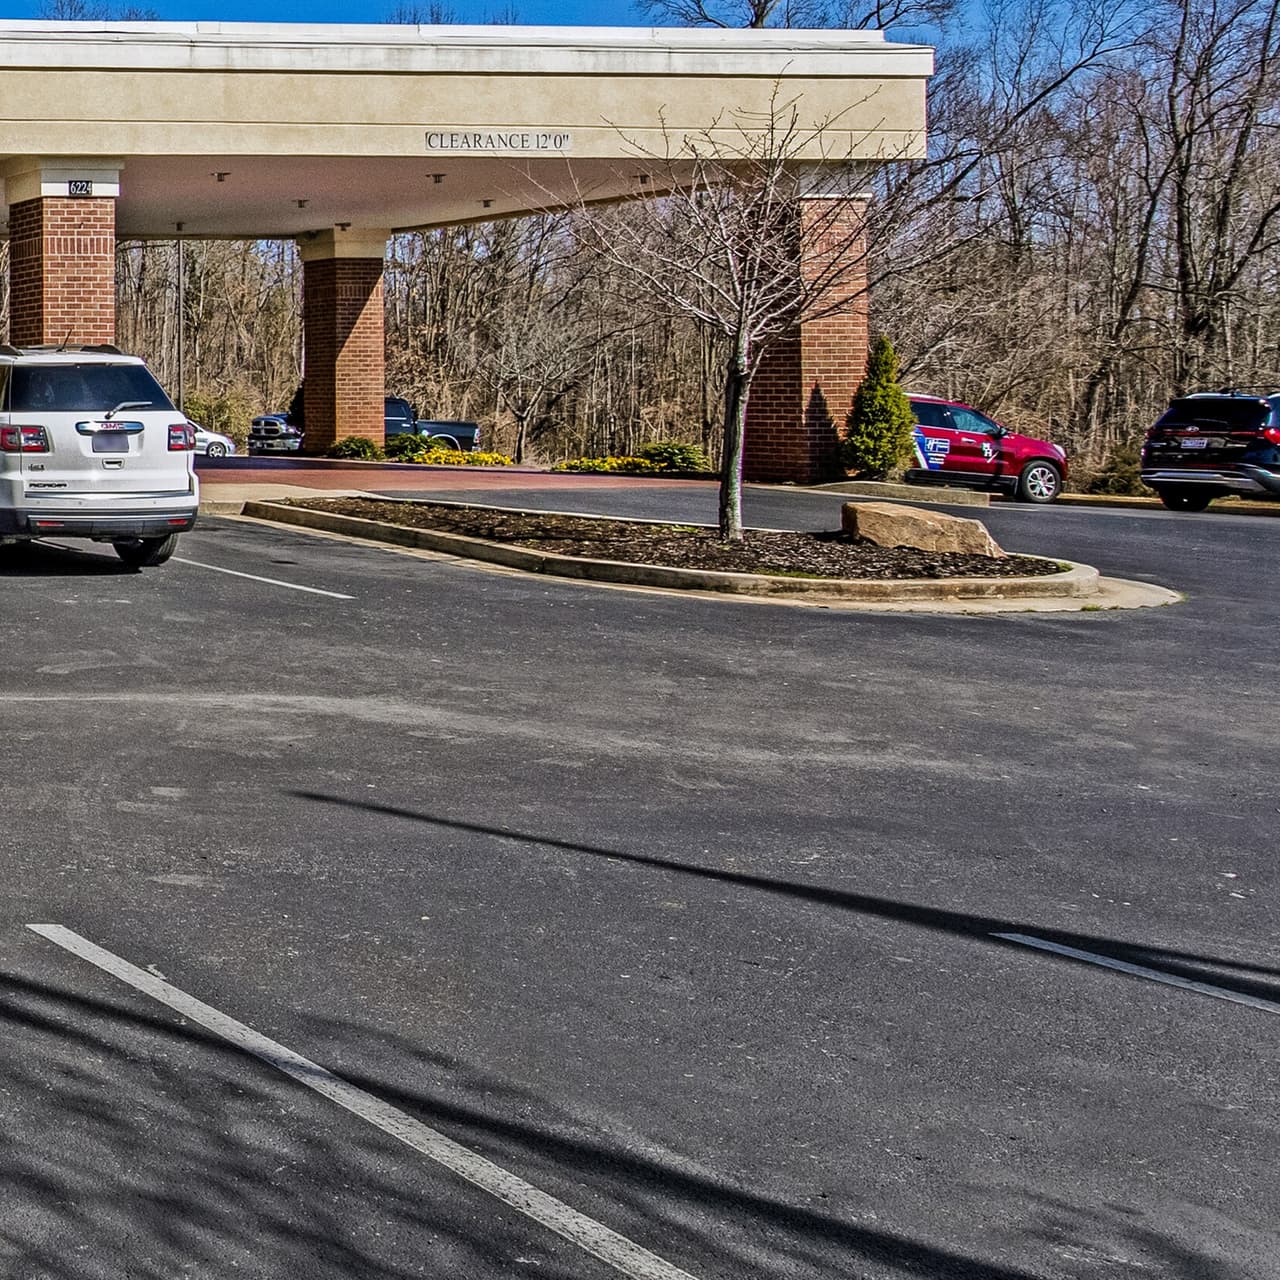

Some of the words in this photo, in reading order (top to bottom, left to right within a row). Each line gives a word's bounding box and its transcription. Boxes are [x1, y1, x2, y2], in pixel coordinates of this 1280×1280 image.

[427, 132, 530, 149] CLEARANCE
[70, 181, 92, 194] 6224
[100, 422, 125, 430] GMC
